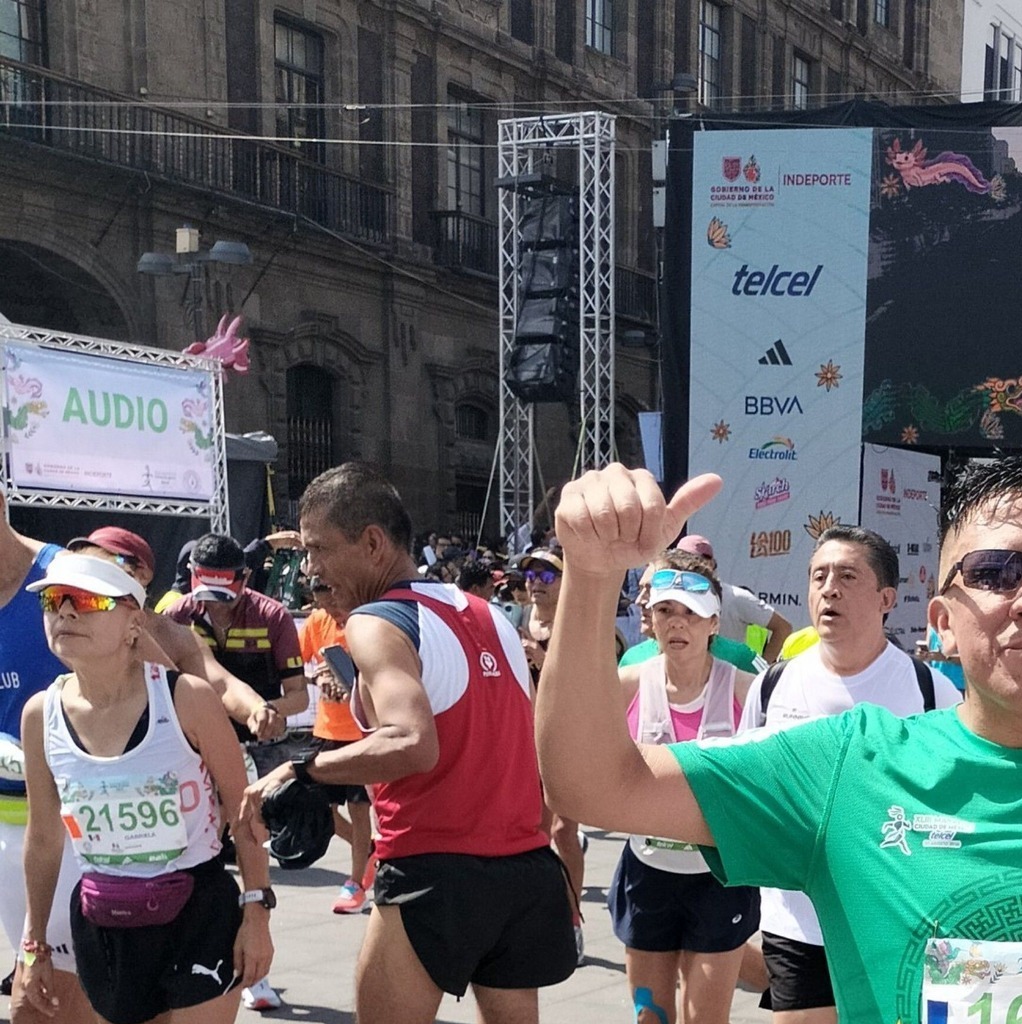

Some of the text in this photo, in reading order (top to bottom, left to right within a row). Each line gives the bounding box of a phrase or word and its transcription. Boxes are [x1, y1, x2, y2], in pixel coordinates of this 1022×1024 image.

[783, 173, 851, 186] INDEPORTE
[710, 185, 750, 193] GOBIERNO
[748, 193, 775, 201] MÉXICO
[732, 265, 824, 297] telcel
[62, 386, 169, 434] AUDIO
[744, 395, 804, 416] BBVA
[748, 448, 798, 461] Electrolit
[79, 798, 180, 833] 21596
